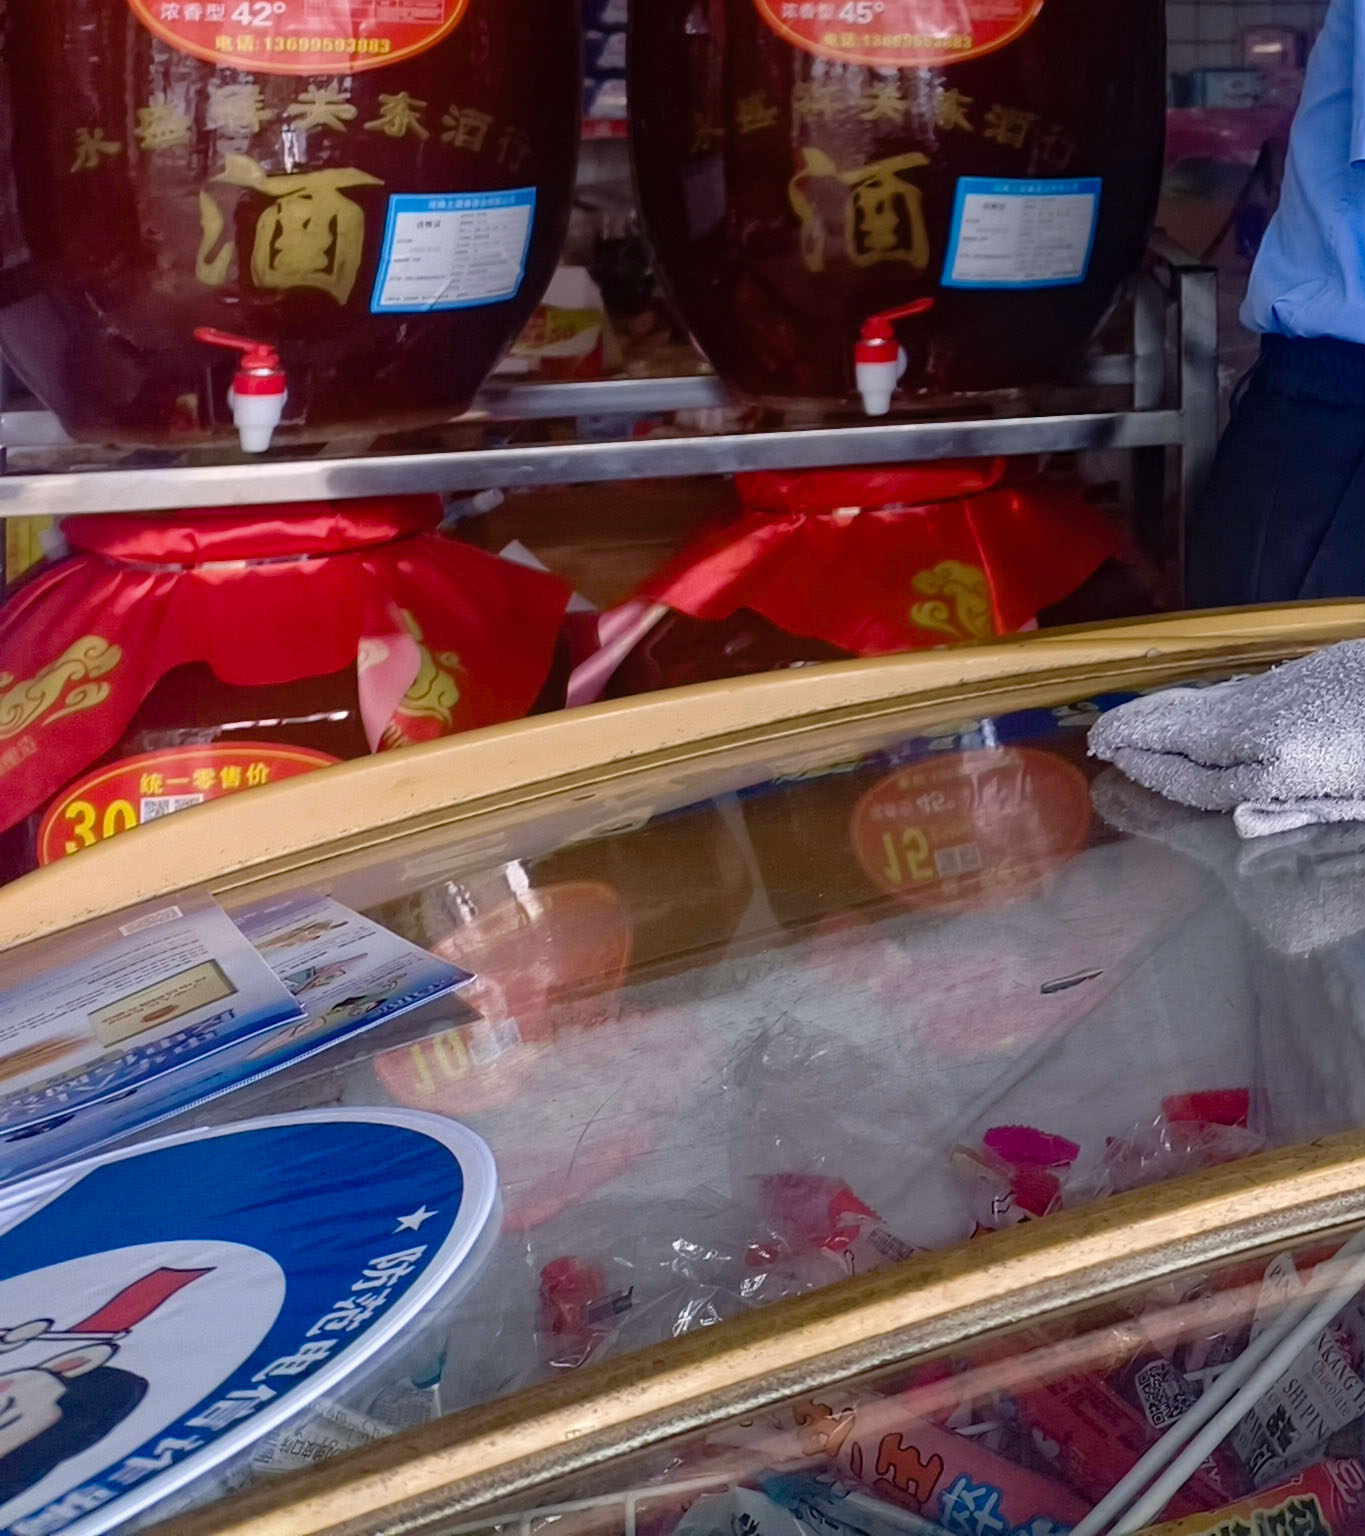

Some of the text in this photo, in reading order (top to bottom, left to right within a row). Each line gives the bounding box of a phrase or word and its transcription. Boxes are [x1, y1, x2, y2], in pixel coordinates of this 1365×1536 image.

[160, 1, 287, 27] 浓香型 42°
[837, 0, 887, 25] 45°
[140, 761, 271, 795] 统一零售价
[64, 799, 138, 855] 30
